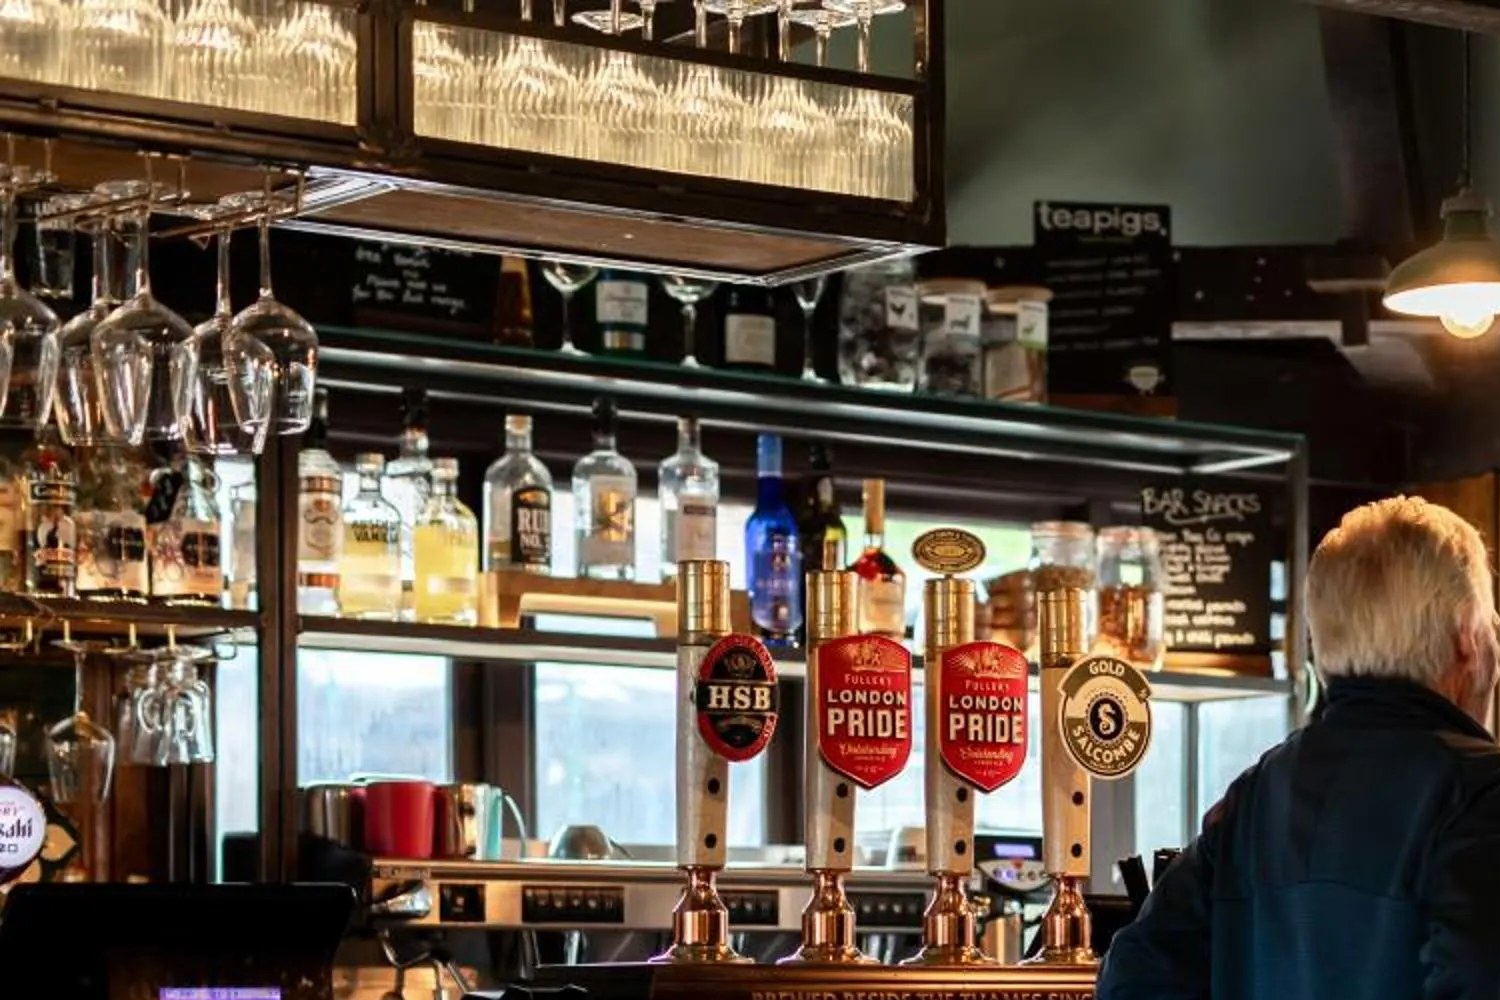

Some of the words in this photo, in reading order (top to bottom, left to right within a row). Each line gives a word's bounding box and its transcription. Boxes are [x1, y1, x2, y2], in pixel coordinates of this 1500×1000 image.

[1141, 488, 1189, 516] BAR
[1193, 490, 1262, 517] SNACKS
[1088, 660, 1125, 676] GOLD
[707, 685, 771, 710] HSB
[827, 689, 907, 705] LONDON
[949, 695, 1023, 712] LONDON
[827, 707, 908, 739] PRIDE
[949, 713, 1024, 743] PRIDE
[1072, 725, 1140, 763] SALCOMBE
